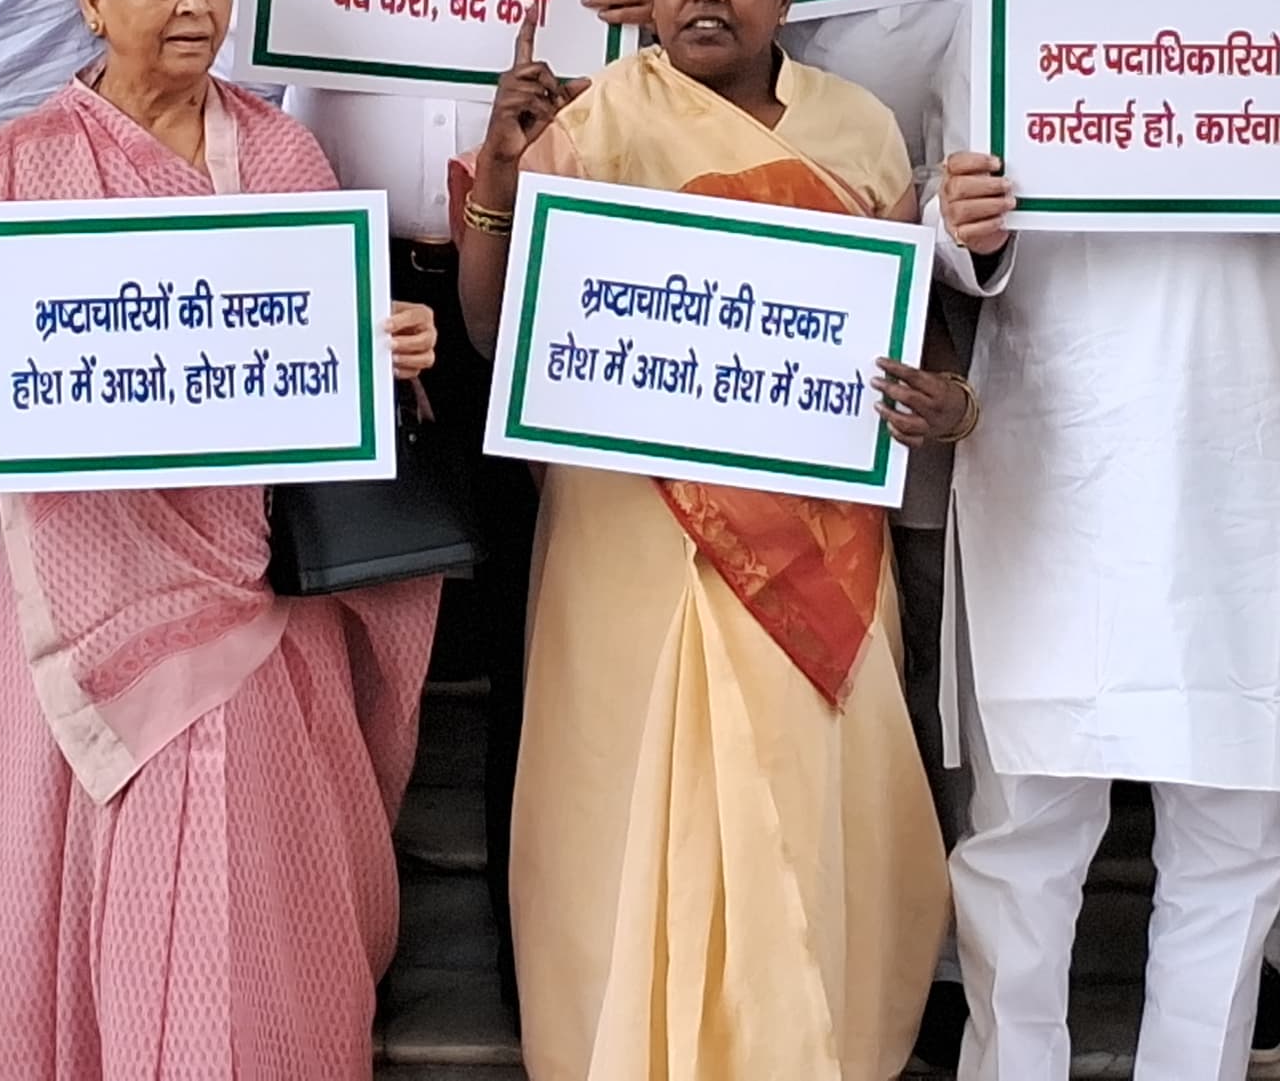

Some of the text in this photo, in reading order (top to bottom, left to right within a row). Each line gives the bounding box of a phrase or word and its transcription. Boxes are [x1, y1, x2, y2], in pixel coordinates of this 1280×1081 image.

[1040, 44, 1097, 81] भ्रष्ट
[1027, 100, 1135, 149] कार्रवाई
[1143, 101, 1183, 148] हो,
[36, 279, 310, 341] भ्रष्टाचारियों की सरकार
[582, 274, 848, 345] भ्रष्टाचारियों की सरकार
[11, 347, 338, 409] होश में आओ, होश में आओ
[548, 331, 864, 416] होश में आओ, होश में आओ
